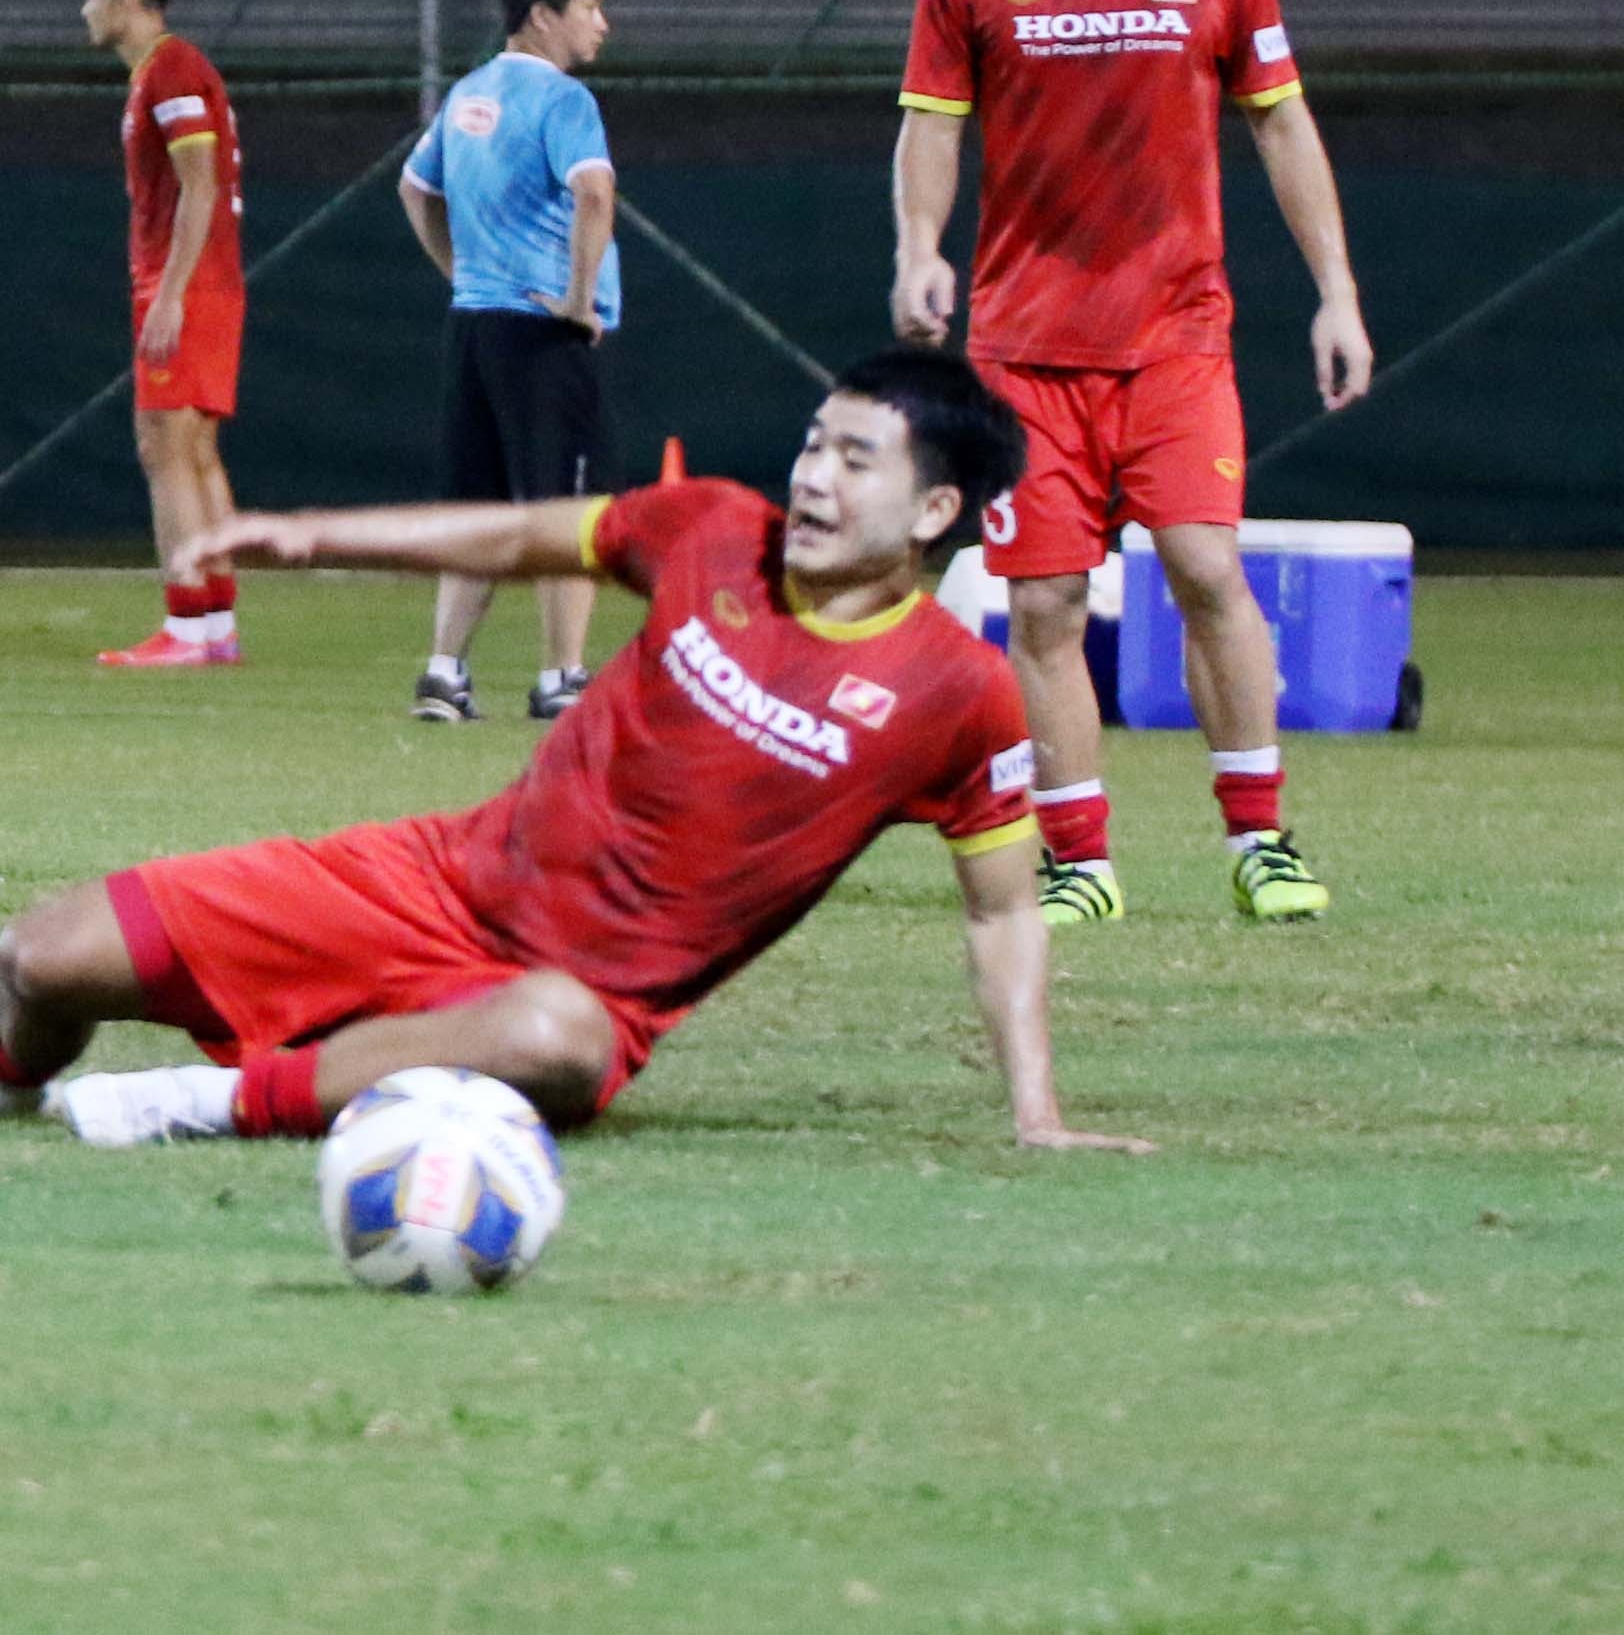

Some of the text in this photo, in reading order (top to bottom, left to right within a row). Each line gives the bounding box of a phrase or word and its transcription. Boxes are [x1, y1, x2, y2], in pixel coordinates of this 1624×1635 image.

[1013, 10, 1191, 40] HONDA
[1051, 41, 1102, 56] Power
[1104, 39, 1121, 54] of
[670, 615, 850, 765] HONDA
